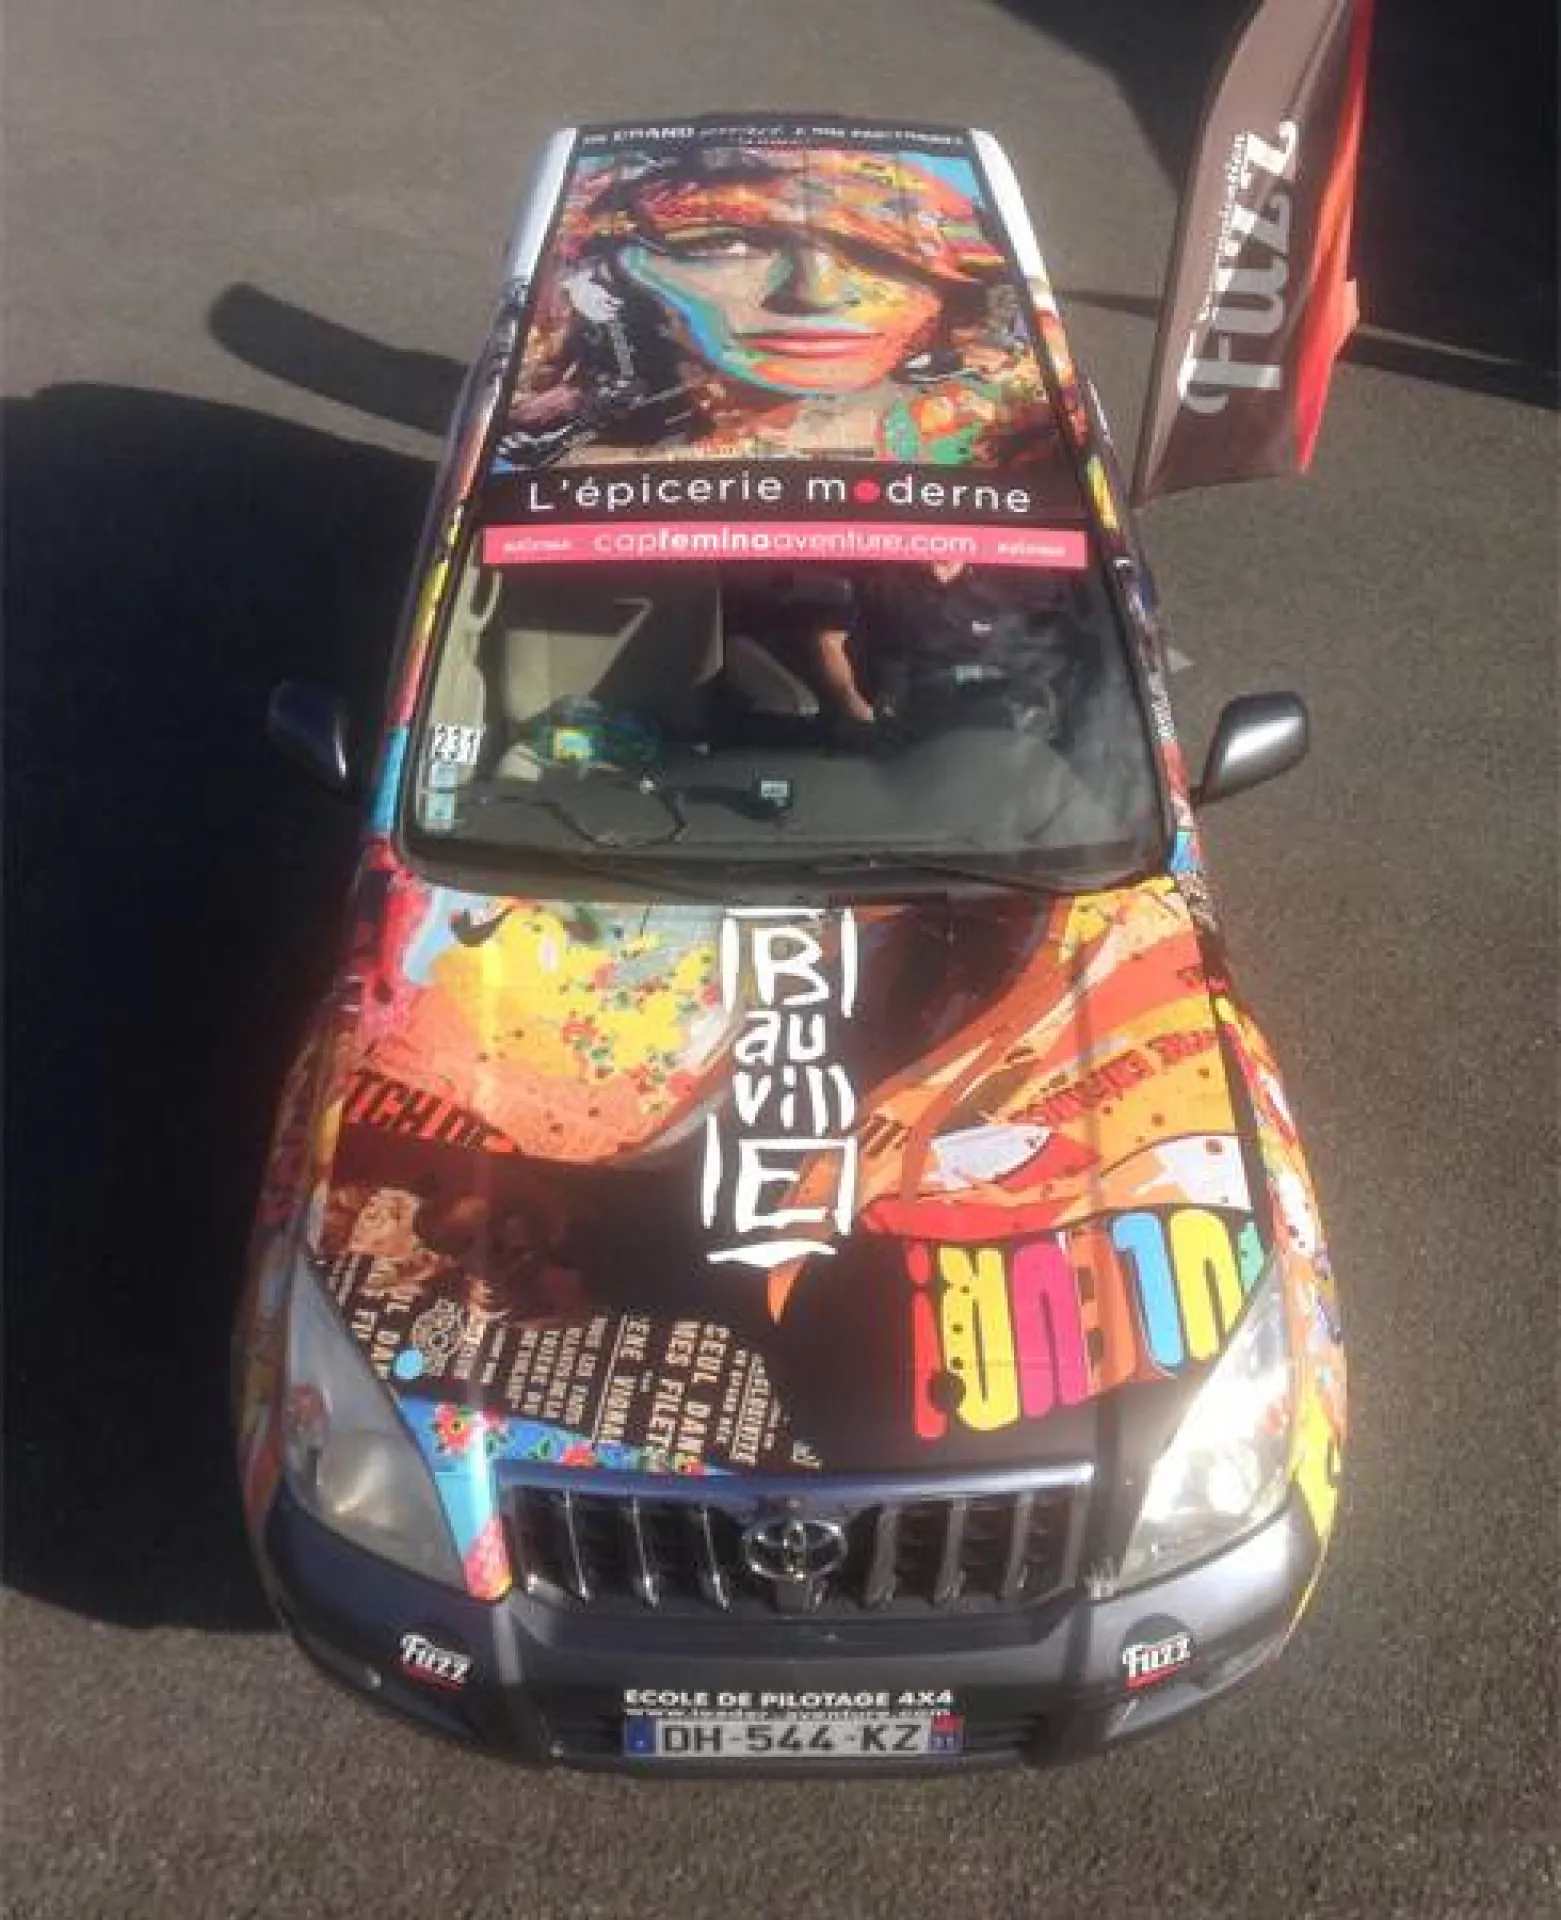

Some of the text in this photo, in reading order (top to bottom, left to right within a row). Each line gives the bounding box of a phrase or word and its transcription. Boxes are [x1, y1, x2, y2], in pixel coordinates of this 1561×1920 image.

[527, 470, 783, 513] L'épicerie
[624, 1689, 708, 1706] ECOLE
[717, 1691, 753, 1706] DE
[761, 1691, 890, 1707] PILOTAGE
[664, 1723, 923, 1752] DH-544-KZ
